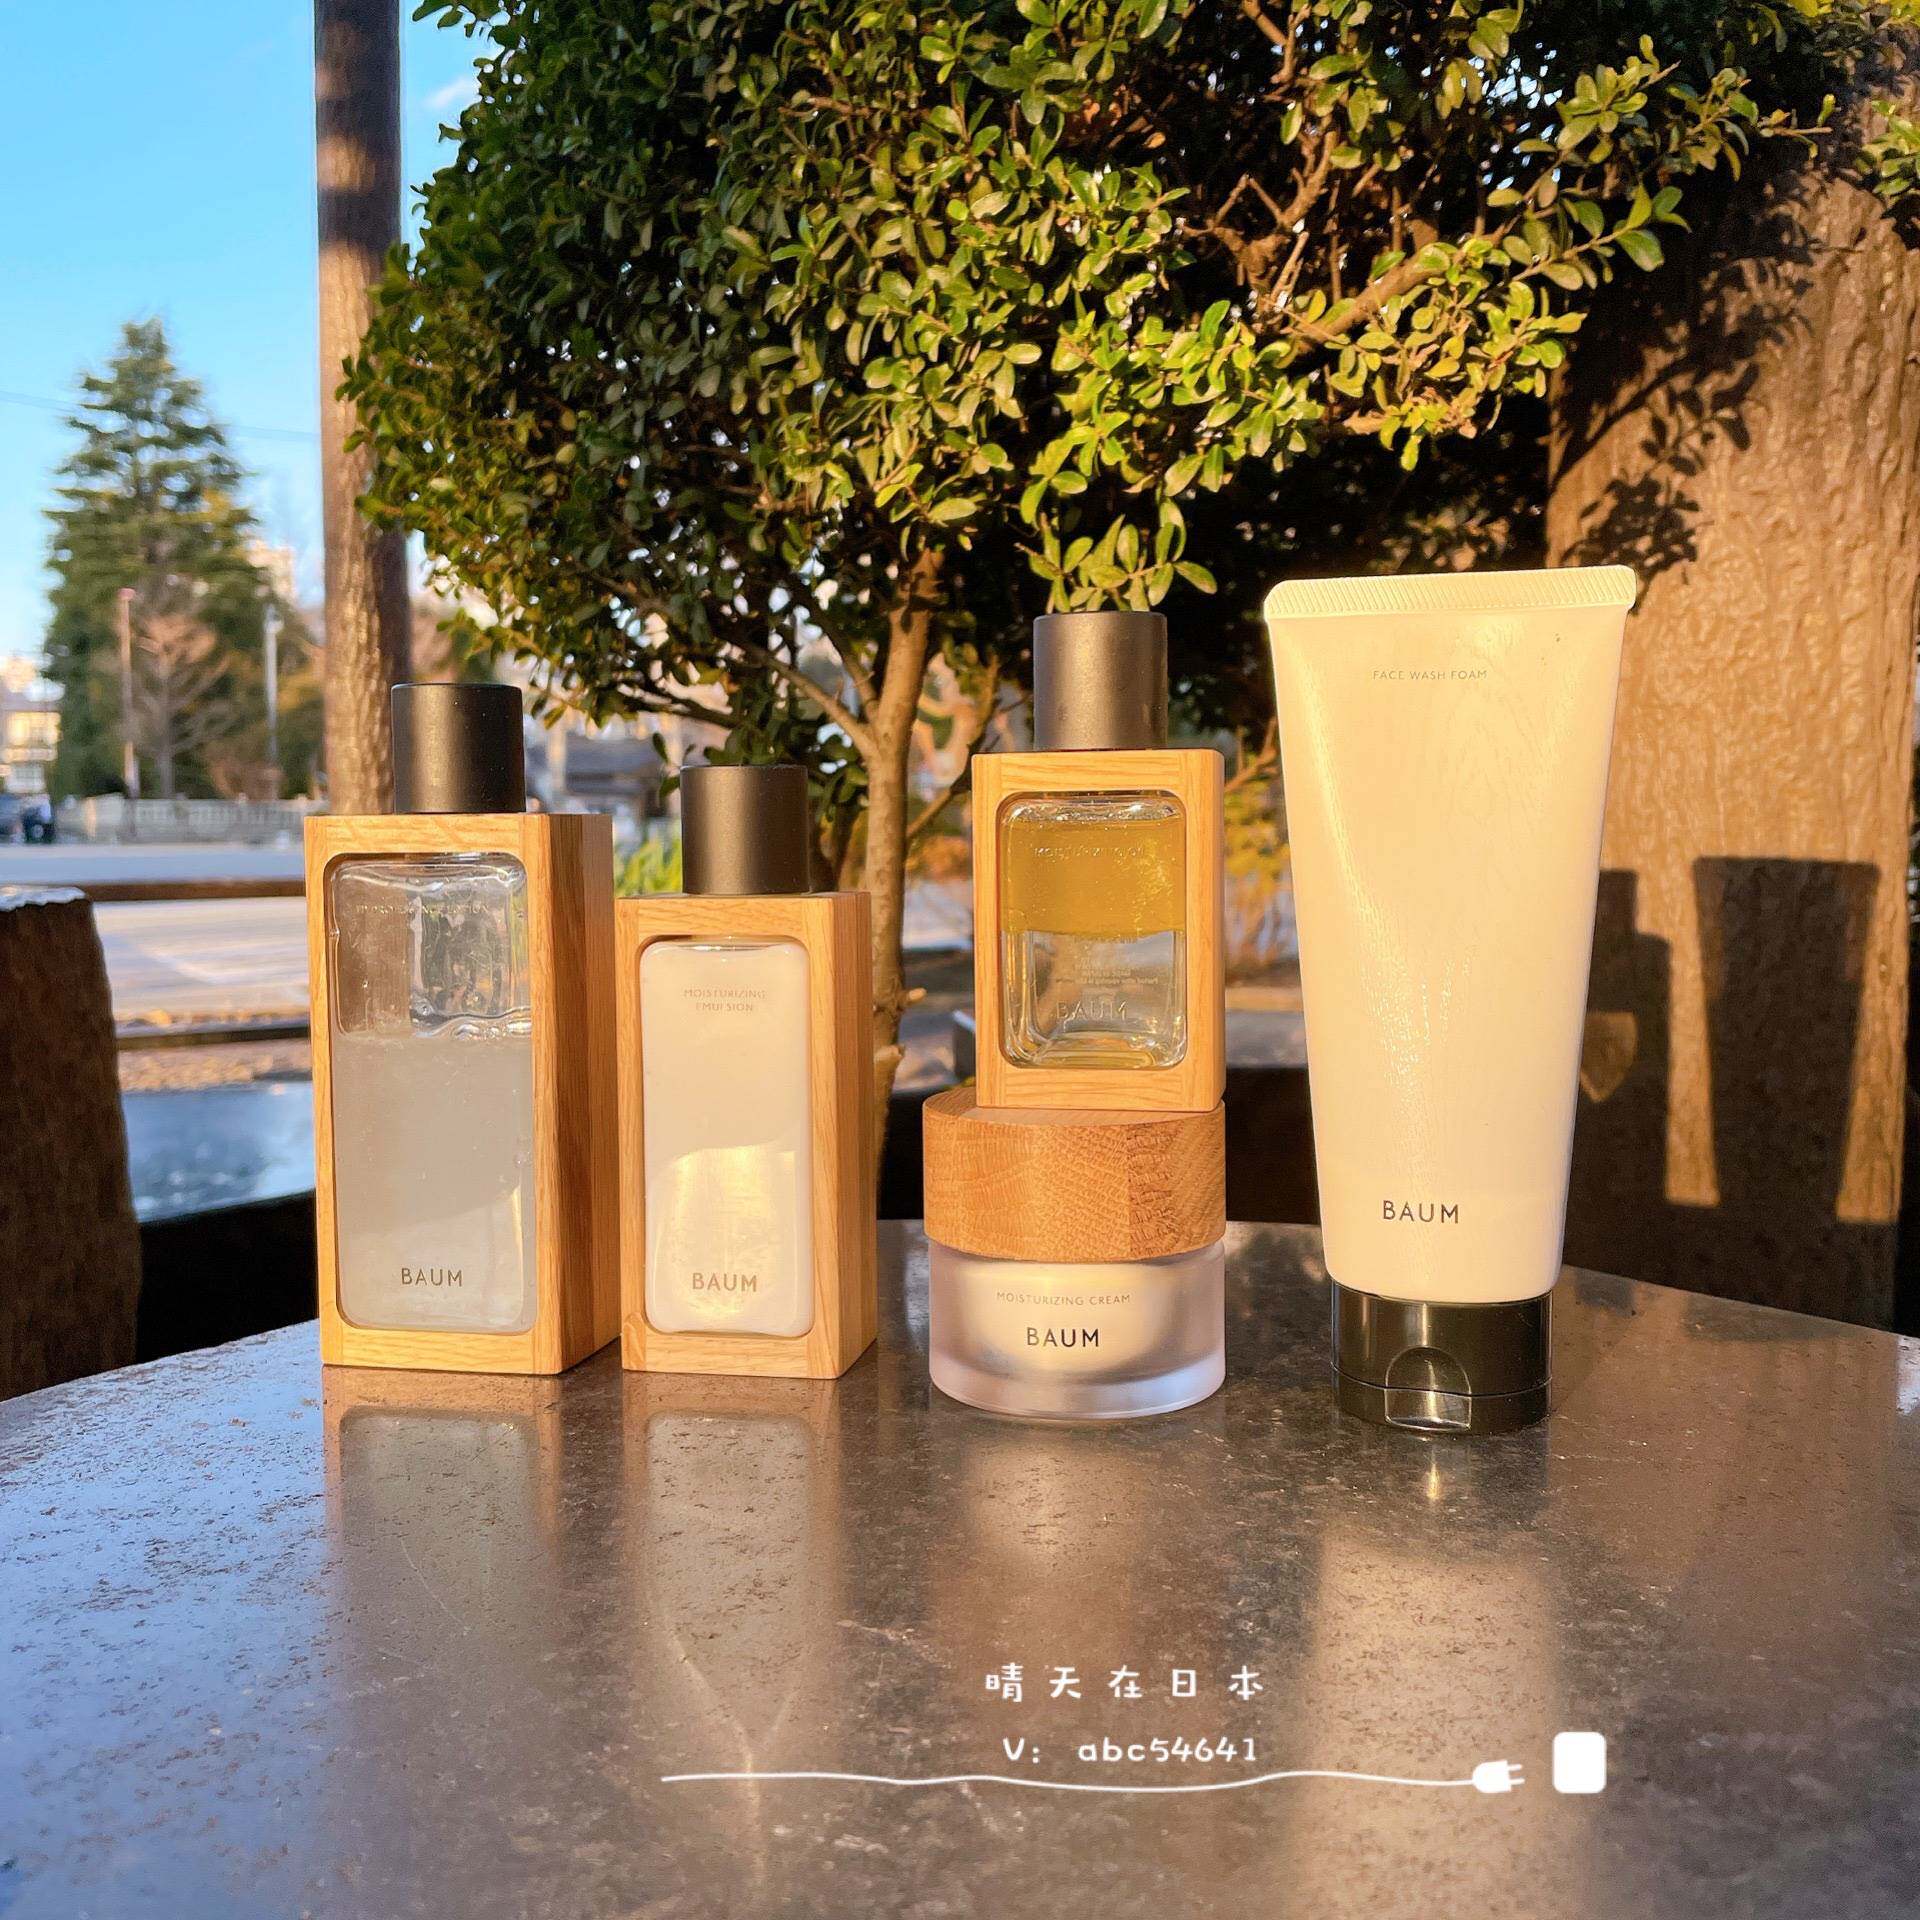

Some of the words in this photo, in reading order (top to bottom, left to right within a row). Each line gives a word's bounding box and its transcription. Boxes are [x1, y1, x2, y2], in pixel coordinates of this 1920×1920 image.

[1373, 670, 1405, 680] FACE
[1409, 670, 1446, 680] WASH
[1450, 669, 1488, 680] FOAM
[683, 988, 767, 999] MOISTURIZING
[1382, 1199, 1459, 1224] BAUM
[401, 1267, 463, 1287] BAUM
[692, 1272, 757, 1293] BAUM
[997, 1292, 1084, 1306] MOISTURIZING
[1089, 1294, 1131, 1306] CREAM
[1026, 1326, 1099, 1347] BAUM
